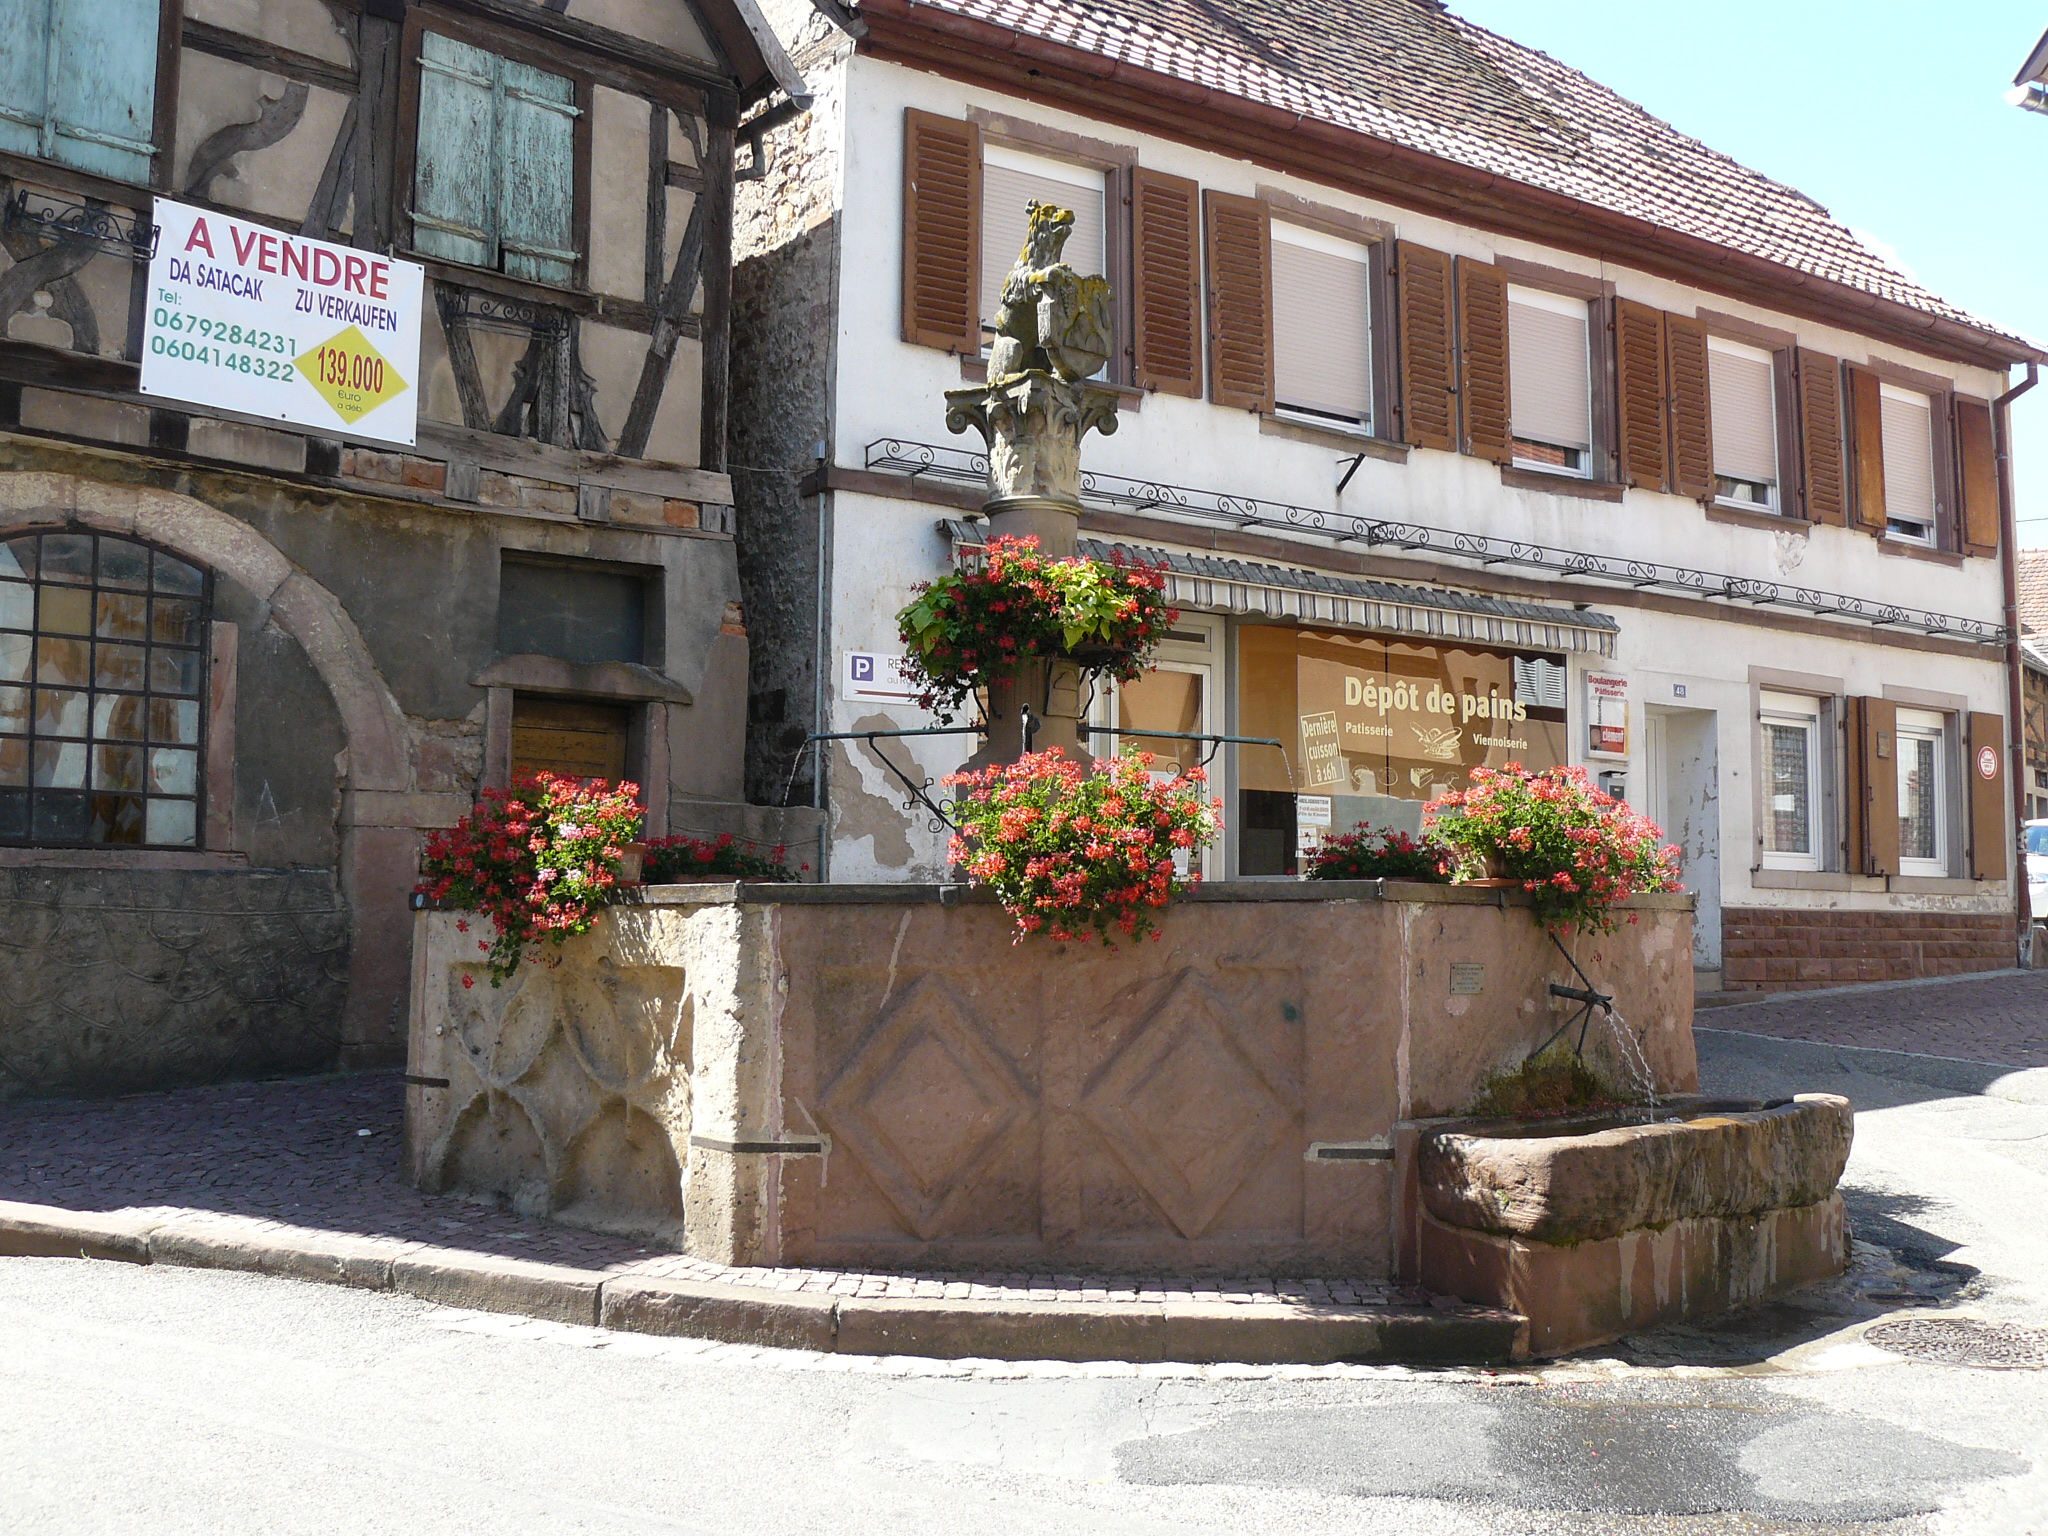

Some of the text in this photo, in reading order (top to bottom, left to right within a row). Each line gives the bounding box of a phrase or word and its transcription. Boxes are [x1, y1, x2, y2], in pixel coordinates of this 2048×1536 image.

[184, 217, 389, 301] A VENDRE
[158, 288, 182, 305] Tel:
[170, 258, 263, 302] DA SATACAK
[295, 288, 397, 332] ZU VERKAUFEN
[153, 308, 297, 357] 0679284231
[151, 335, 294, 383] 0604148322
[318, 346, 383, 394] 139.000
[1588, 675, 1628, 688] Boulangerie
[1345, 676, 1527, 724] Dépôt de pains
[1302, 716, 1337, 738] Dernière
[1345, 721, 1394, 737] Patisserie
[1472, 733, 1528, 750] Viennoiserie
[1308, 741, 1339, 761] cuisson
[1316, 764, 1322, 782] à
